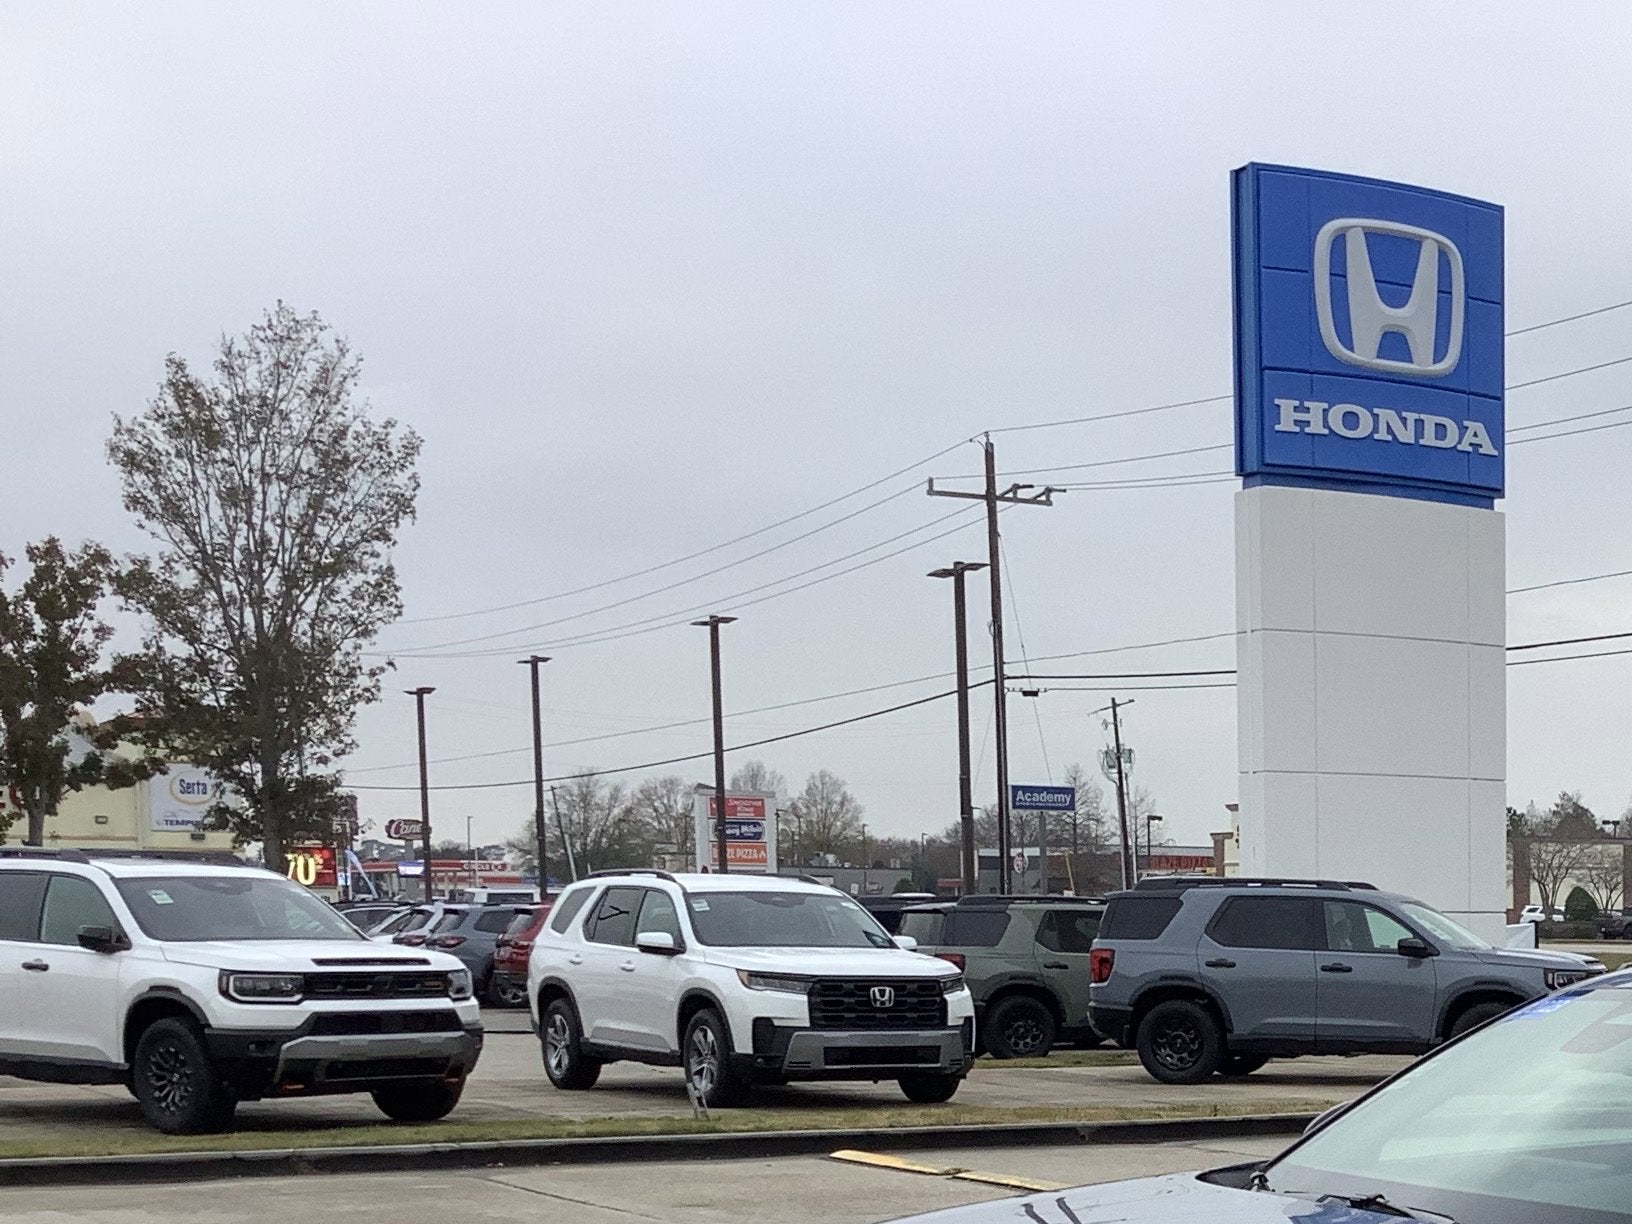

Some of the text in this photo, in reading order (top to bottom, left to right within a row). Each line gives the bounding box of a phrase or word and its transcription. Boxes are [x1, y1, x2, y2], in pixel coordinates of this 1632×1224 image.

[1273, 397, 1499, 457] HONDA
[178, 777, 208, 795] Serta
[1015, 790, 1072, 806] Academy
